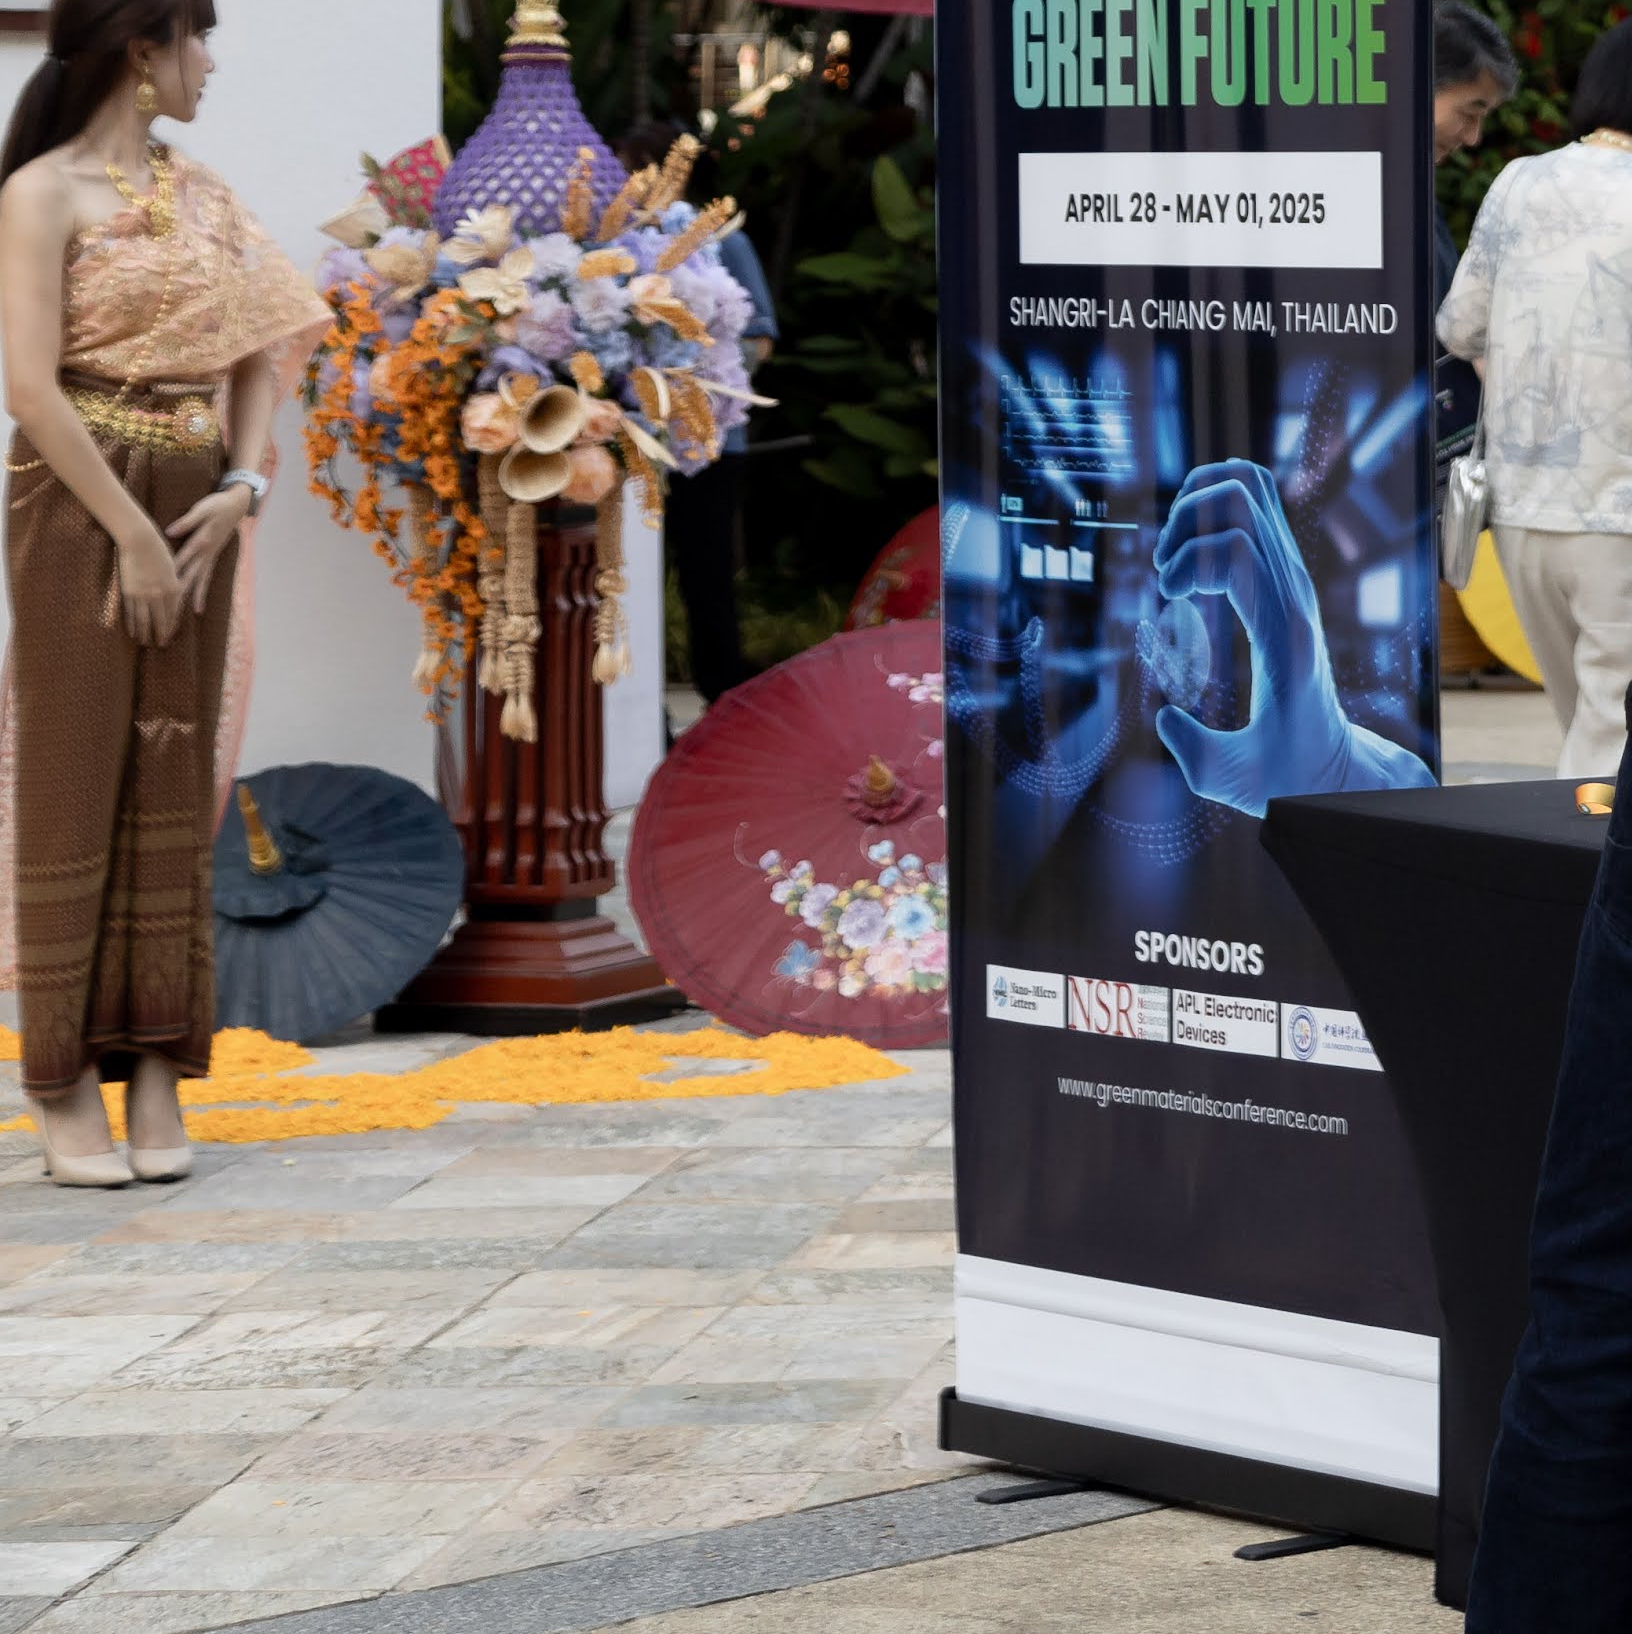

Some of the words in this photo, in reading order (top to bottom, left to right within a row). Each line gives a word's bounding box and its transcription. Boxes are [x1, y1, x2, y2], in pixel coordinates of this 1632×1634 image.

[1065, 192, 1124, 223] APRIL
[1129, 192, 1156, 223] 28
[1176, 193, 1230, 224] MAY
[1236, 193, 1263, 229] 01,
[1269, 192, 1326, 225] 2025
[1010, 296, 1134, 329] SHANGRI-LA
[1141, 298, 1226, 330] CHIANG
[1233, 300, 1277, 338] MAI,
[1281, 301, 1398, 334] THAILAND
[1135, 930, 1265, 976] SPONSORS
[1009, 982, 1057, 999] Nano-Micro
[1010, 997, 1037, 1011] Letters
[1068, 975, 1137, 1038] NSR
[1176, 992, 1200, 1015] APL
[1204, 996, 1276, 1024] Electronic
[1177, 1020, 1227, 1046] Devices
[1057, 1076, 1349, 1135] www.greenmaterialsconference.com
